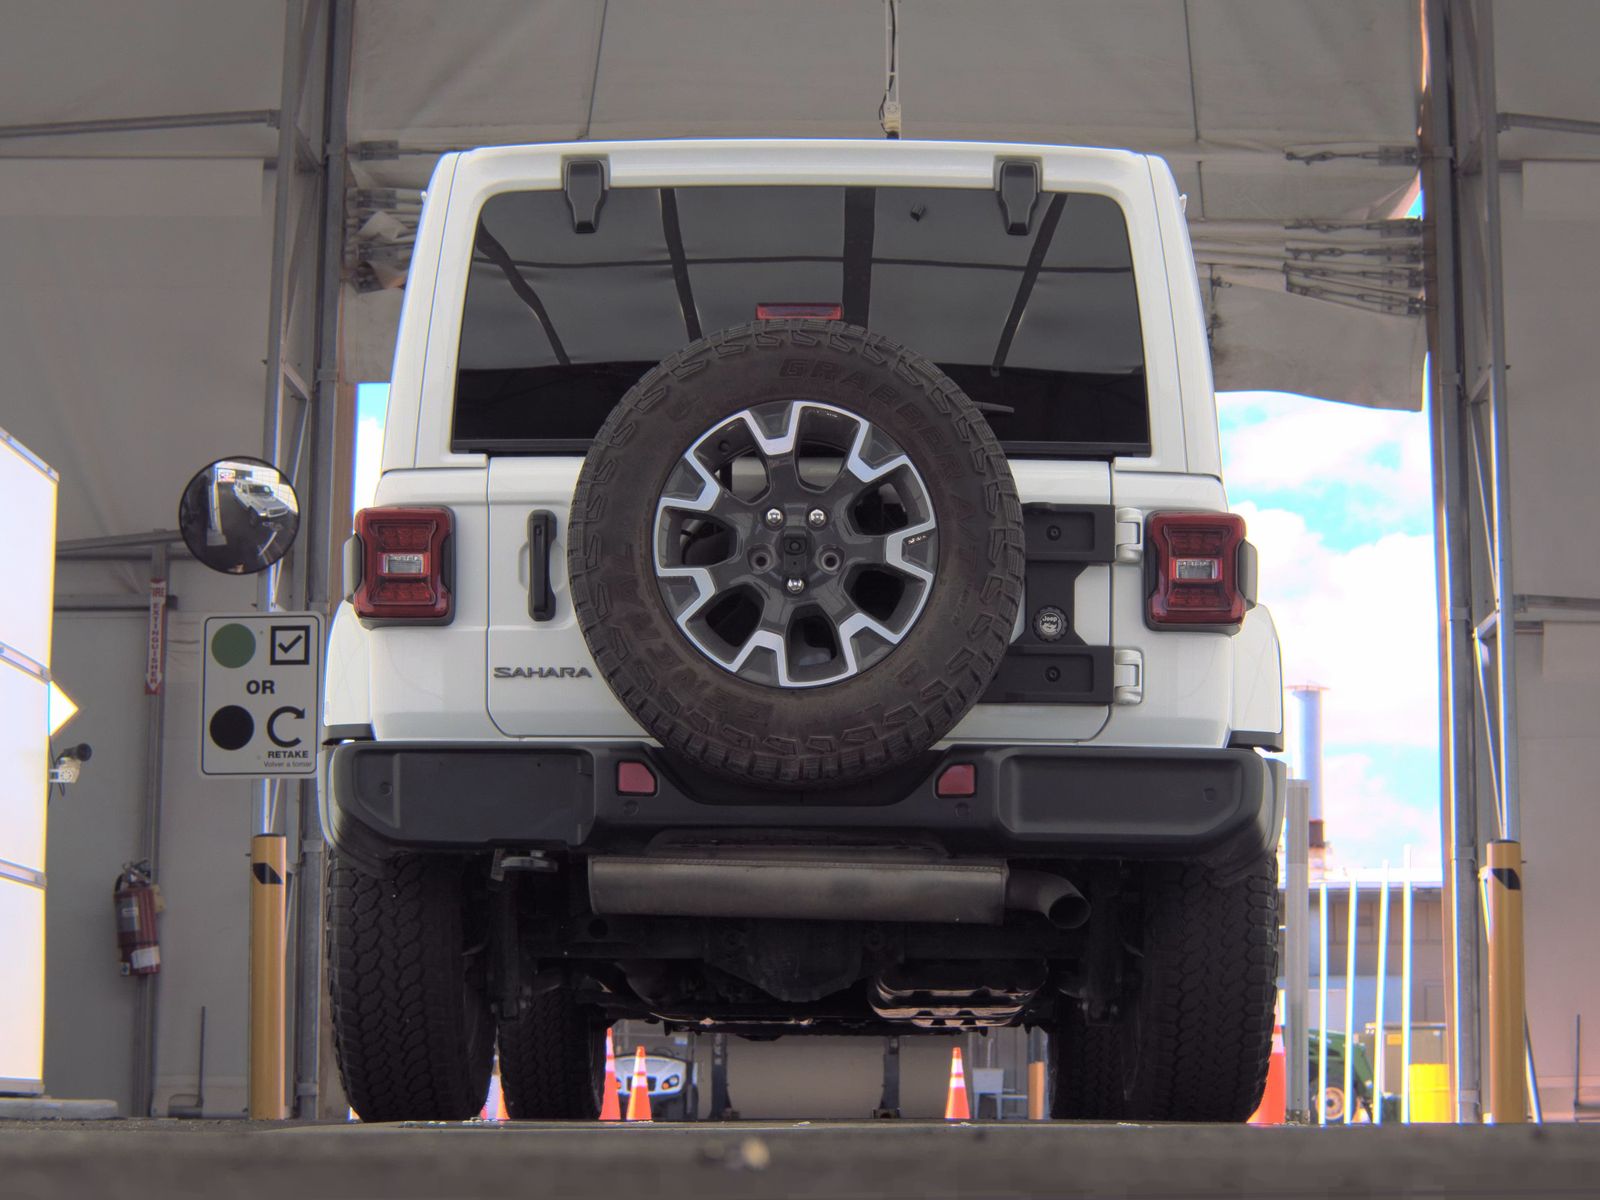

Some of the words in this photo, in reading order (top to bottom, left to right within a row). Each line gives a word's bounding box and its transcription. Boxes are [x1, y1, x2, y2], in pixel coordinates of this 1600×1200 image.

[779, 358, 964, 480] GRABBER
[151, 603, 159, 683] EXTINGUISHER
[494, 667, 592, 678] SAHARA
[246, 680, 275, 694] OR
[268, 750, 308, 758] RETAKE
